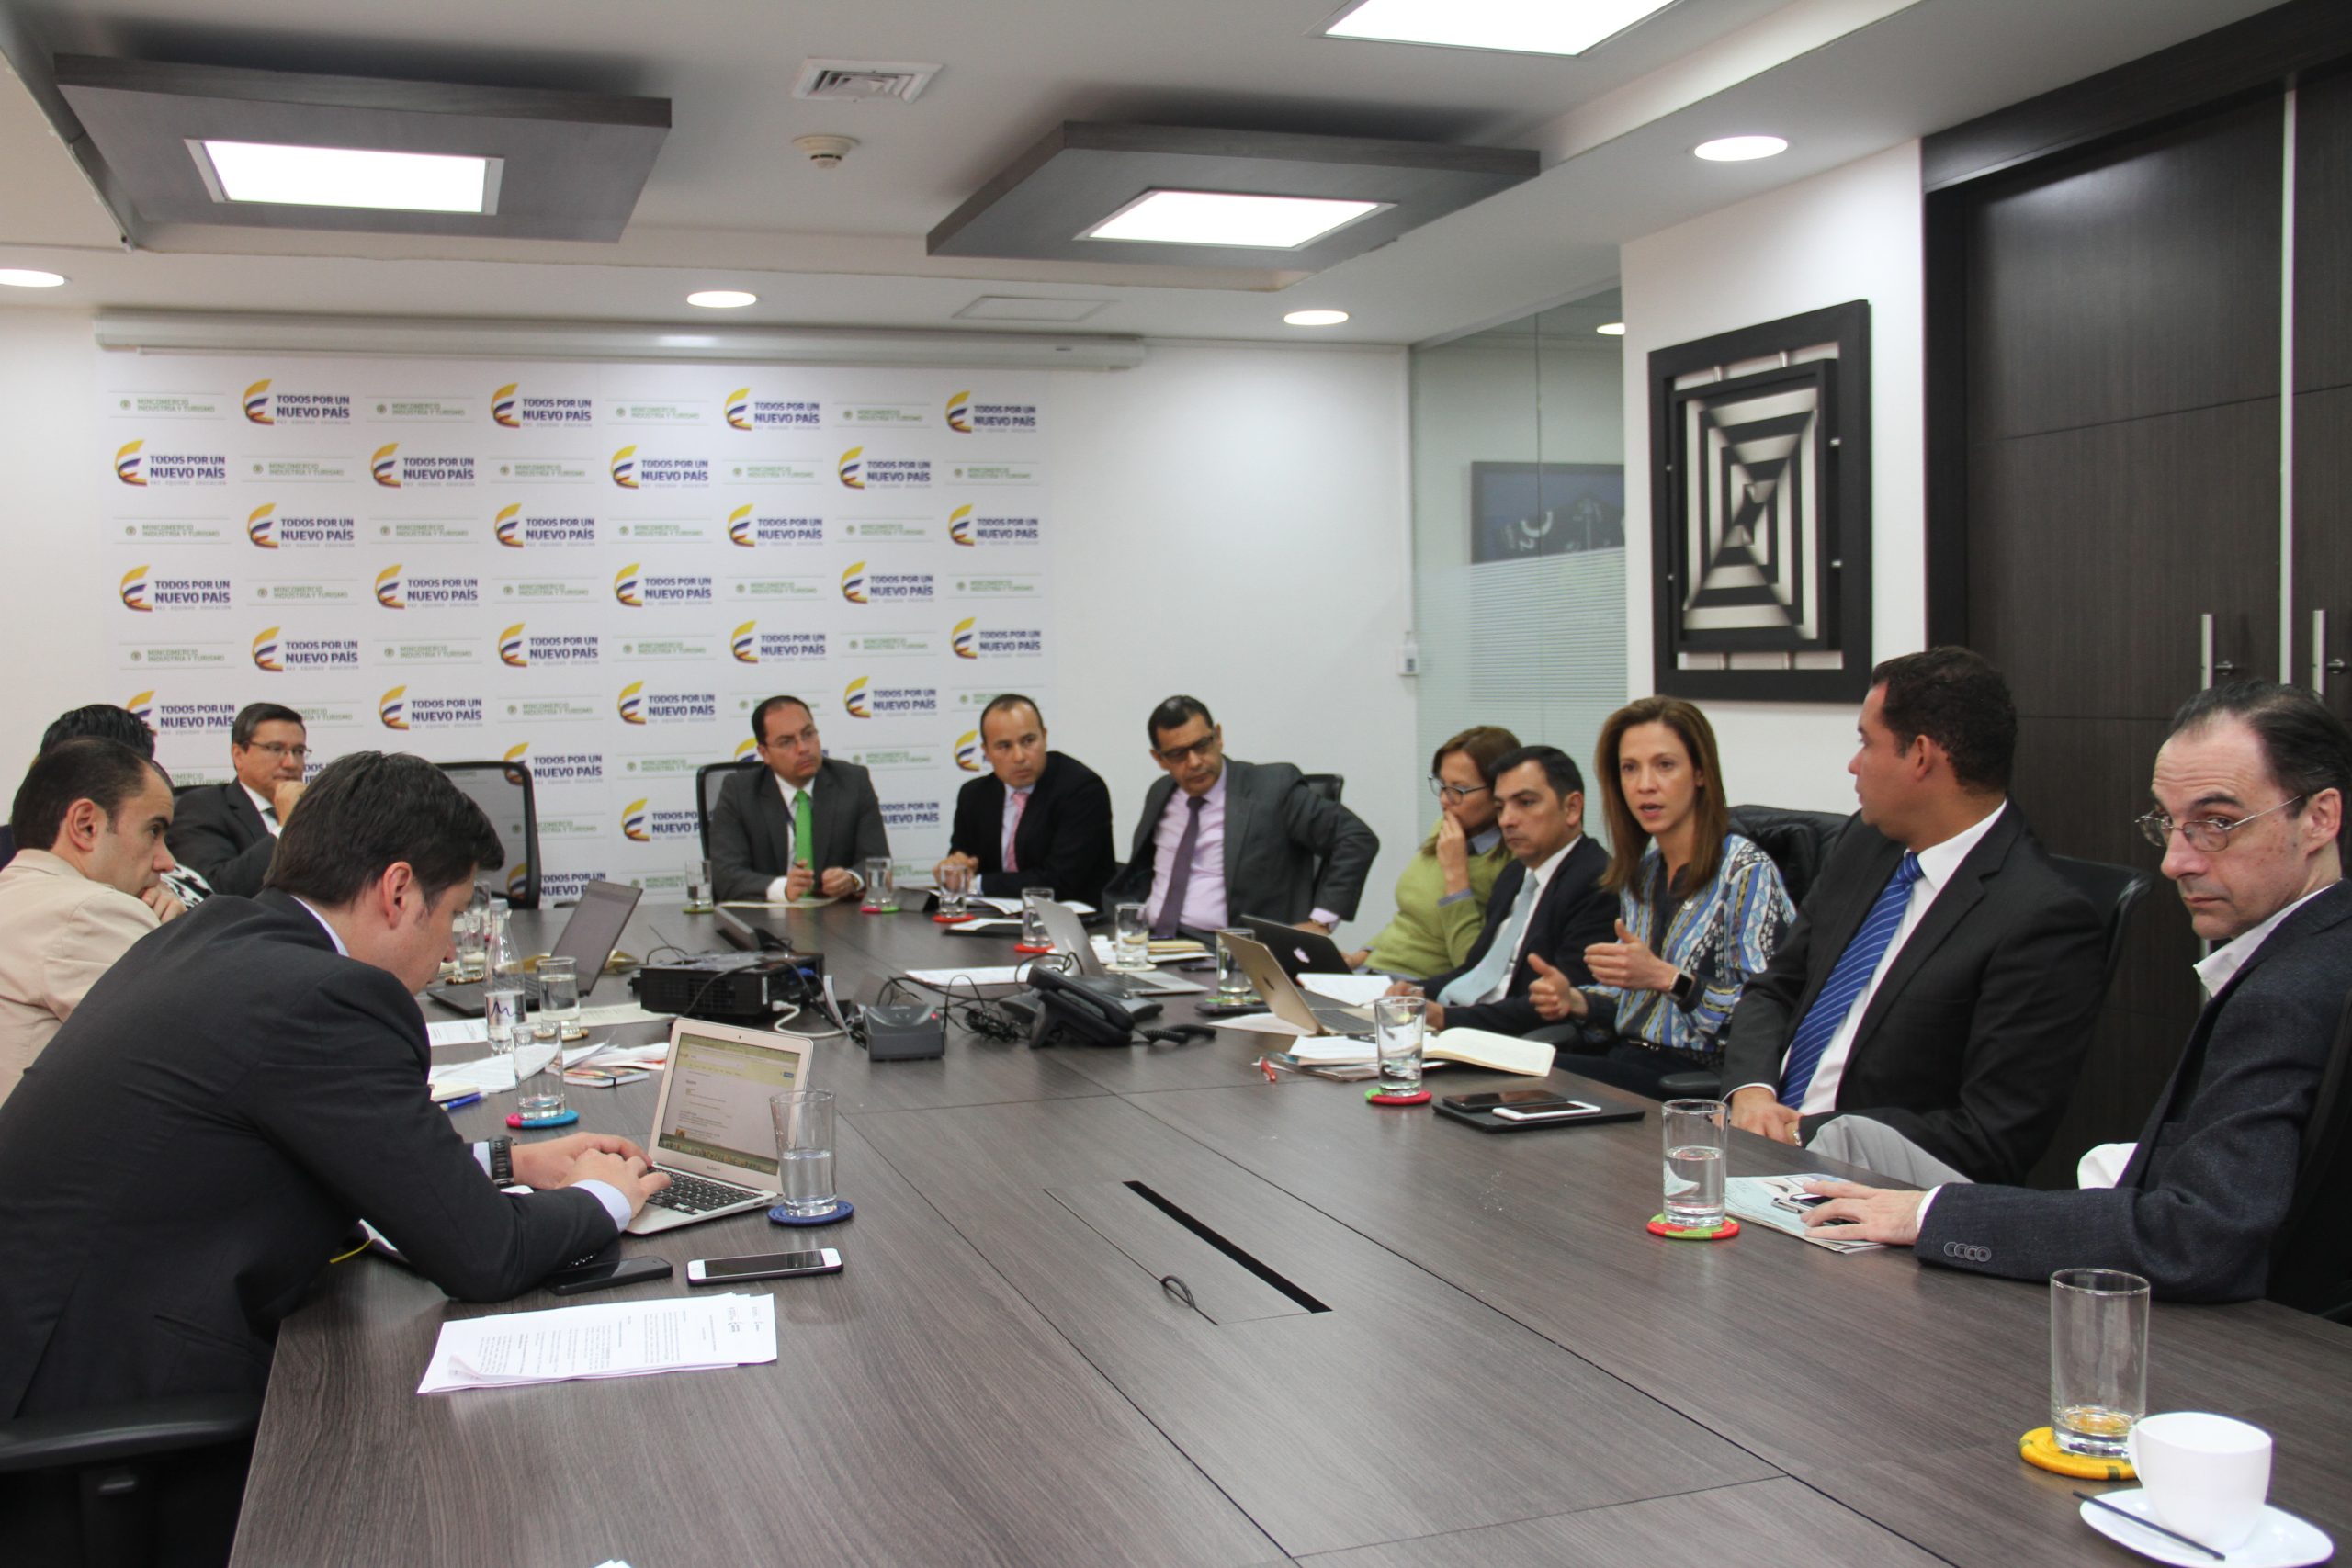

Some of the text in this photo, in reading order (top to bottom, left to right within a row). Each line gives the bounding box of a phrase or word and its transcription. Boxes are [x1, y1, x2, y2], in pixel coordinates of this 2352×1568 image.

[277, 395, 349, 404] TODOS POR UN
[522, 399, 554, 407] TODOS
[556, 399, 575, 407] POR
[754, 401, 785, 410] TODOS
[807, 402, 820, 411] UN
[1004, 405, 1022, 413] POR
[277, 407, 319, 417] NUEVO
[522, 410, 562, 420] NUEVO
[754, 413, 792, 423] NUEVO
[974, 416, 1010, 425] NUEVO
[150, 456, 224, 464] TODOS POR UN
[403, 457, 435, 466] TODOS
[438, 457, 458, 466] POR
[641, 459, 672, 468] TODOS
[150, 468, 194, 478] NUEVO
[403, 469, 445, 479] NUEVO
[641, 471, 680, 480] NUEVO
[867, 472, 904, 481] NUEVO
[280, 518, 314, 526] TODOS
[316, 518, 337, 526] POR
[526, 518, 594, 526] TODOS POR UN
[757, 518, 822, 526] TODOS POR UN
[280, 530, 323, 540] NUEVO
[526, 530, 566, 539] NUEVO
[757, 529, 796, 539] NUEVO
[977, 529, 1012, 538] NUEVO
[407, 579, 439, 587] TODOS
[442, 579, 461, 587] POR
[870, 575, 899, 583] TODOS
[154, 581, 230, 589] TODOS POR UN
[645, 589, 684, 599] NUEVO
[870, 586, 907, 596] NUEVO
[154, 592, 198, 603] NUEVO
[407, 591, 448, 601] NUEVO
[792, 634, 810, 642] POR
[1010, 630, 1026, 638] POR
[285, 641, 319, 649] TODOS
[321, 641, 341, 649] POR
[529, 637, 597, 646] TODOS POR UN
[979, 641, 1015, 651] NUEVO
[529, 649, 570, 659] NUEVO
[761, 645, 798, 655] NUEVO
[285, 653, 328, 663] NUEVO
[873, 689, 902, 697] TODOS
[649, 694, 679, 703] TODOS
[681, 694, 699, 703] POR
[412, 699, 444, 708] TODOS
[446, 699, 466, 707] POR
[873, 700, 910, 710] NUEVO
[160, 705, 195, 714] TODOS
[197, 705, 218, 713] POR
[648, 705, 687, 716] NUEVO
[411, 711, 452, 721] NUEVO
[160, 716, 204, 728] NUEVO
[534, 756, 565, 764] TODOS
[567, 755, 586, 763] POR
[534, 767, 573, 778] NUEVO
[652, 810, 698, 820] TODOS PO
[883, 814, 913, 824] UEVO
[652, 822, 691, 833] NUEVO
